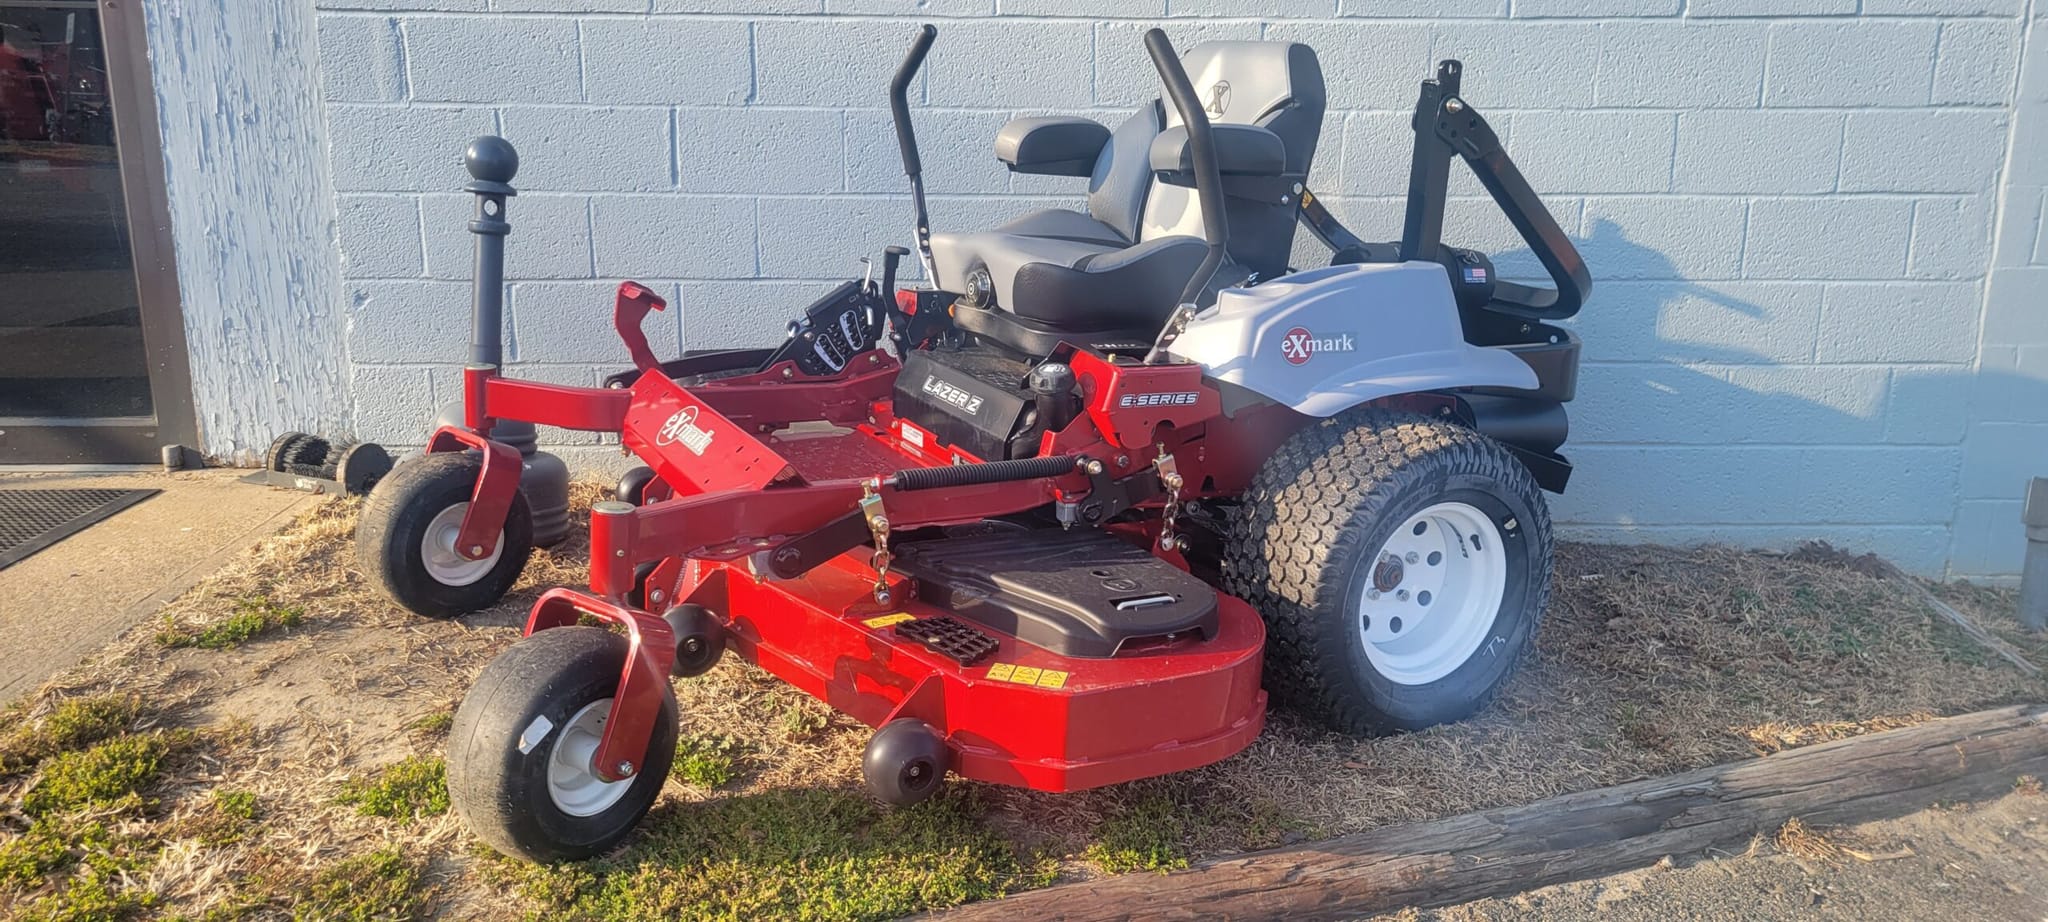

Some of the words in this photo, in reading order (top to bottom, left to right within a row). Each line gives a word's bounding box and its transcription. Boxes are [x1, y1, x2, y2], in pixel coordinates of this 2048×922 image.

[1281, 333, 1353, 358] eXmark
[922, 375, 970, 409] LAZER
[964, 395, 984, 416] Z
[1120, 392, 1199, 408] E-SERIES
[661, 410, 715, 456] eXmark
